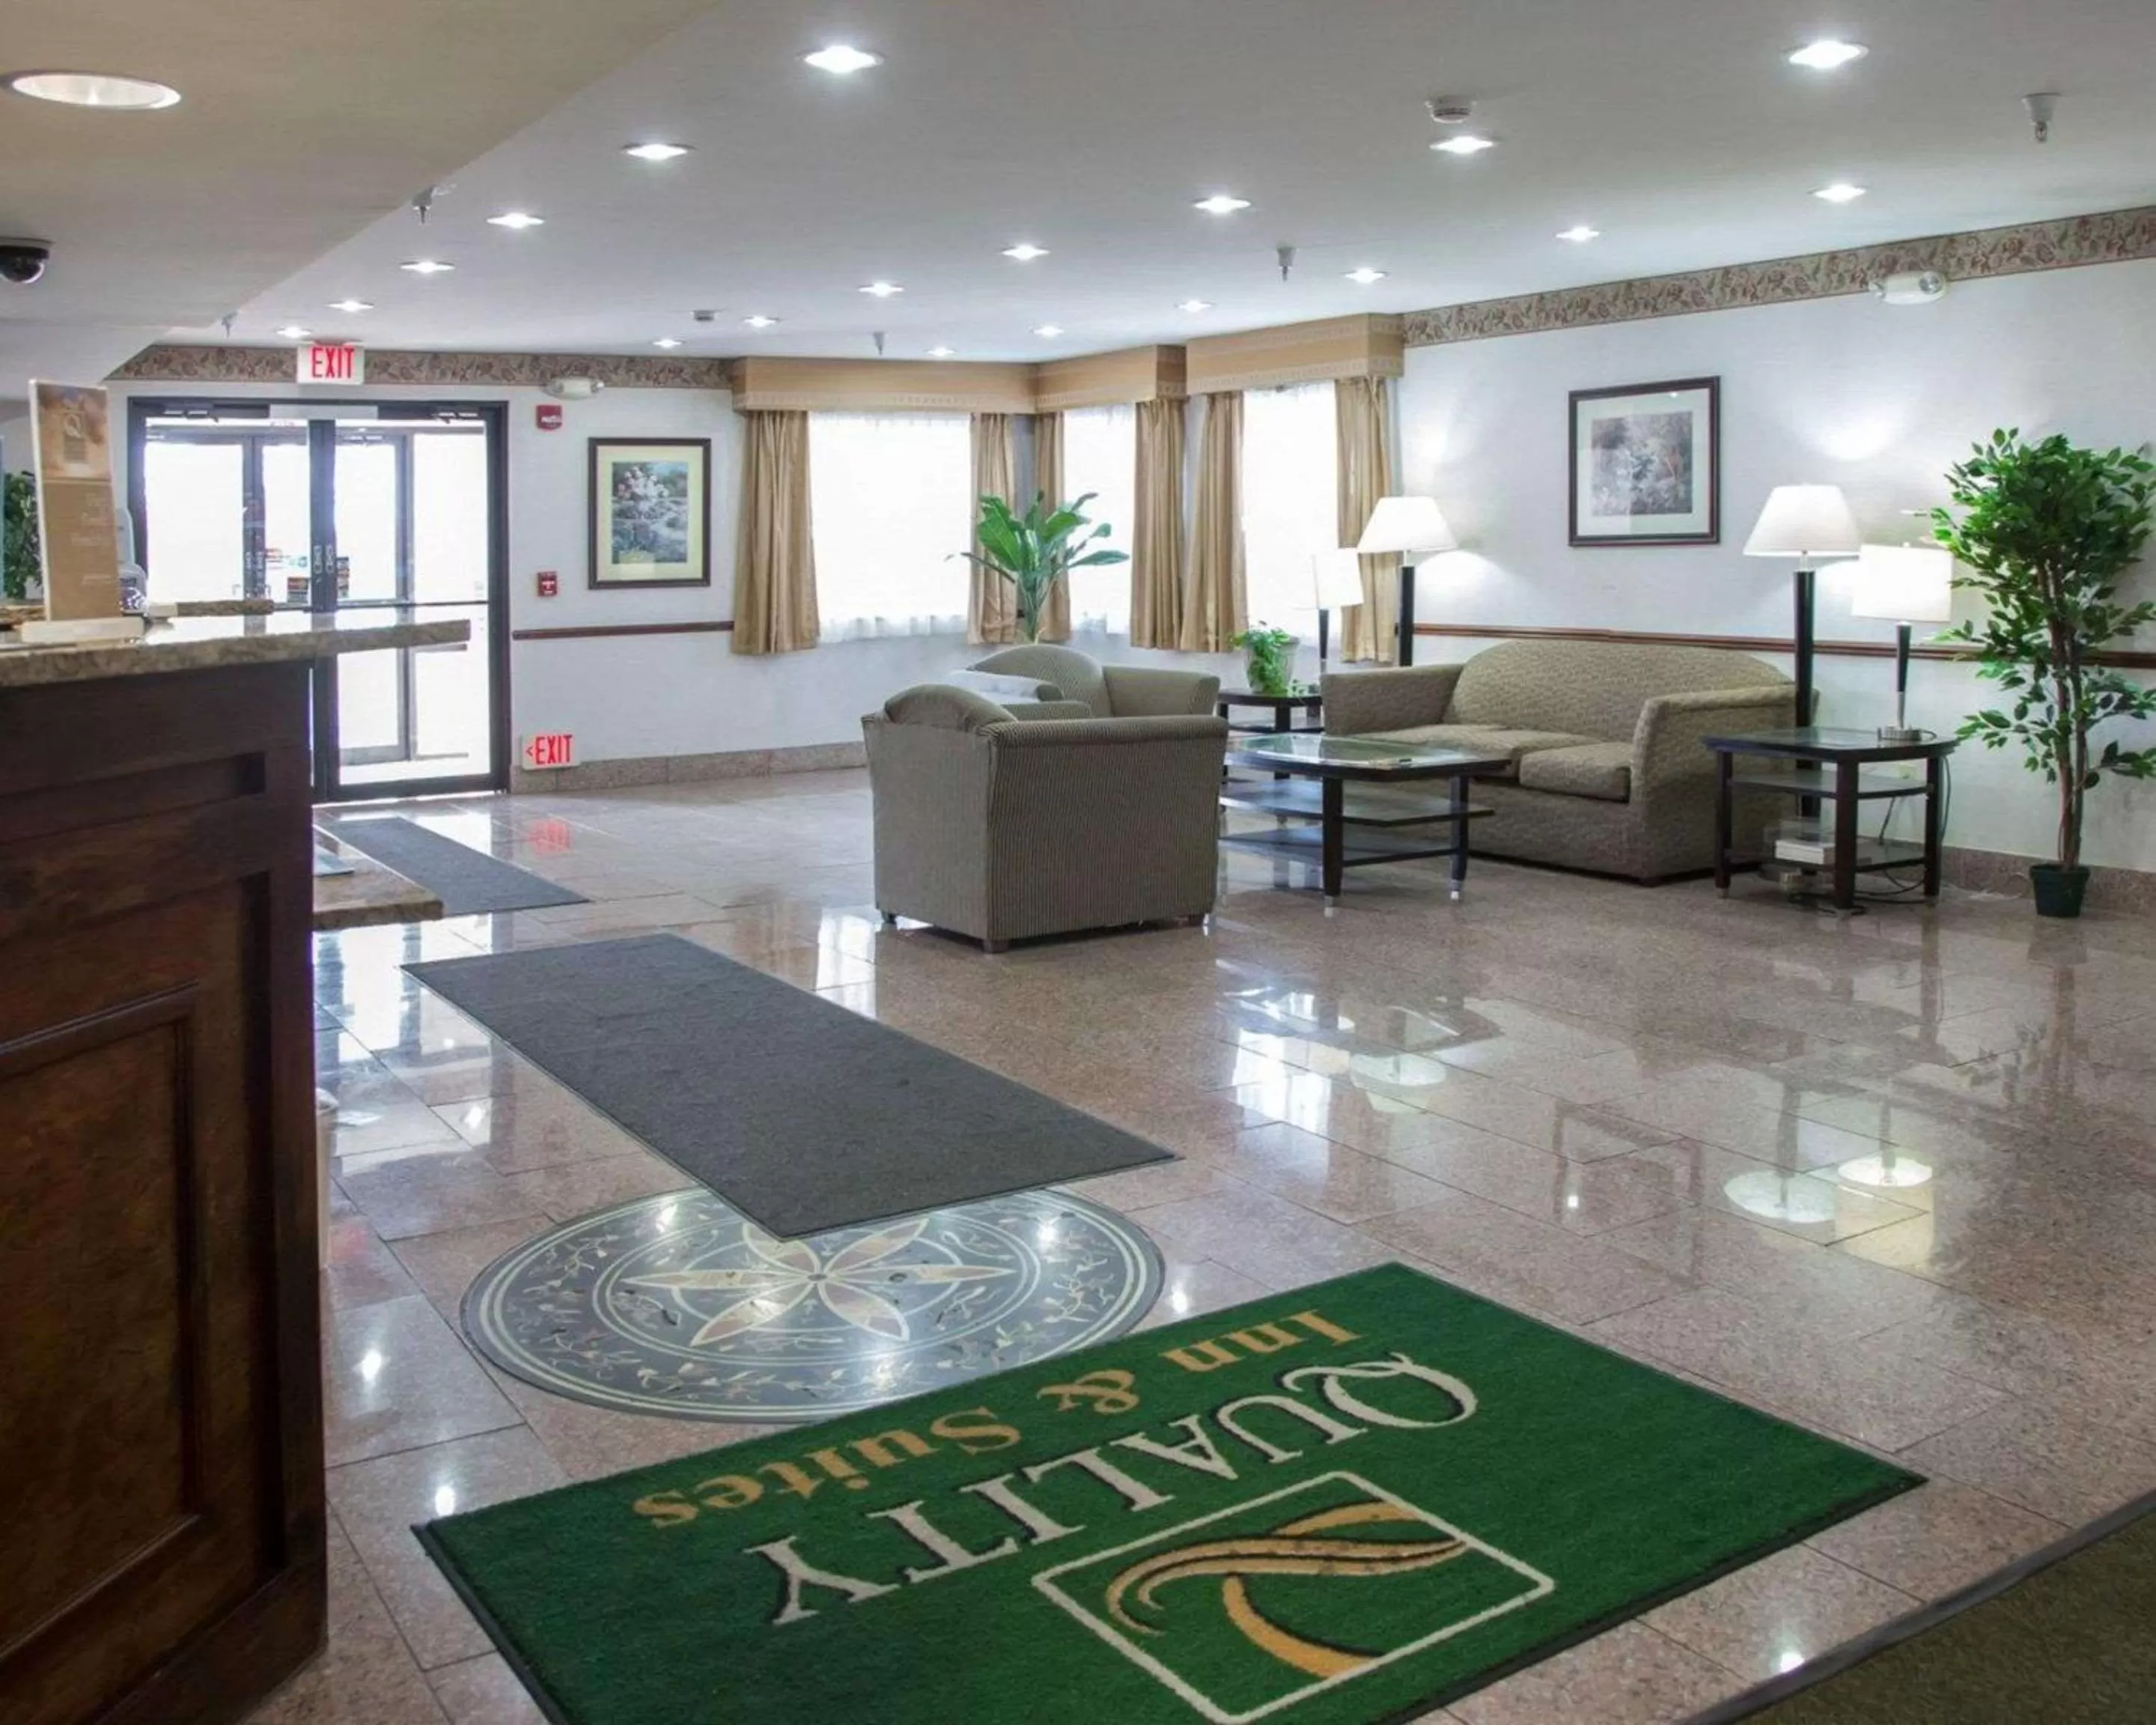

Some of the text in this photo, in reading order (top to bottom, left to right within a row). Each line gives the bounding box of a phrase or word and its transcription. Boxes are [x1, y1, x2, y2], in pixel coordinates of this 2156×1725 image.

[311, 347, 355, 378] EXIT
[535, 734, 573, 764] EXIT
[633, 1309, 1362, 1529] Inn & Suites
[743, 1351, 1479, 1625] QUALITY
